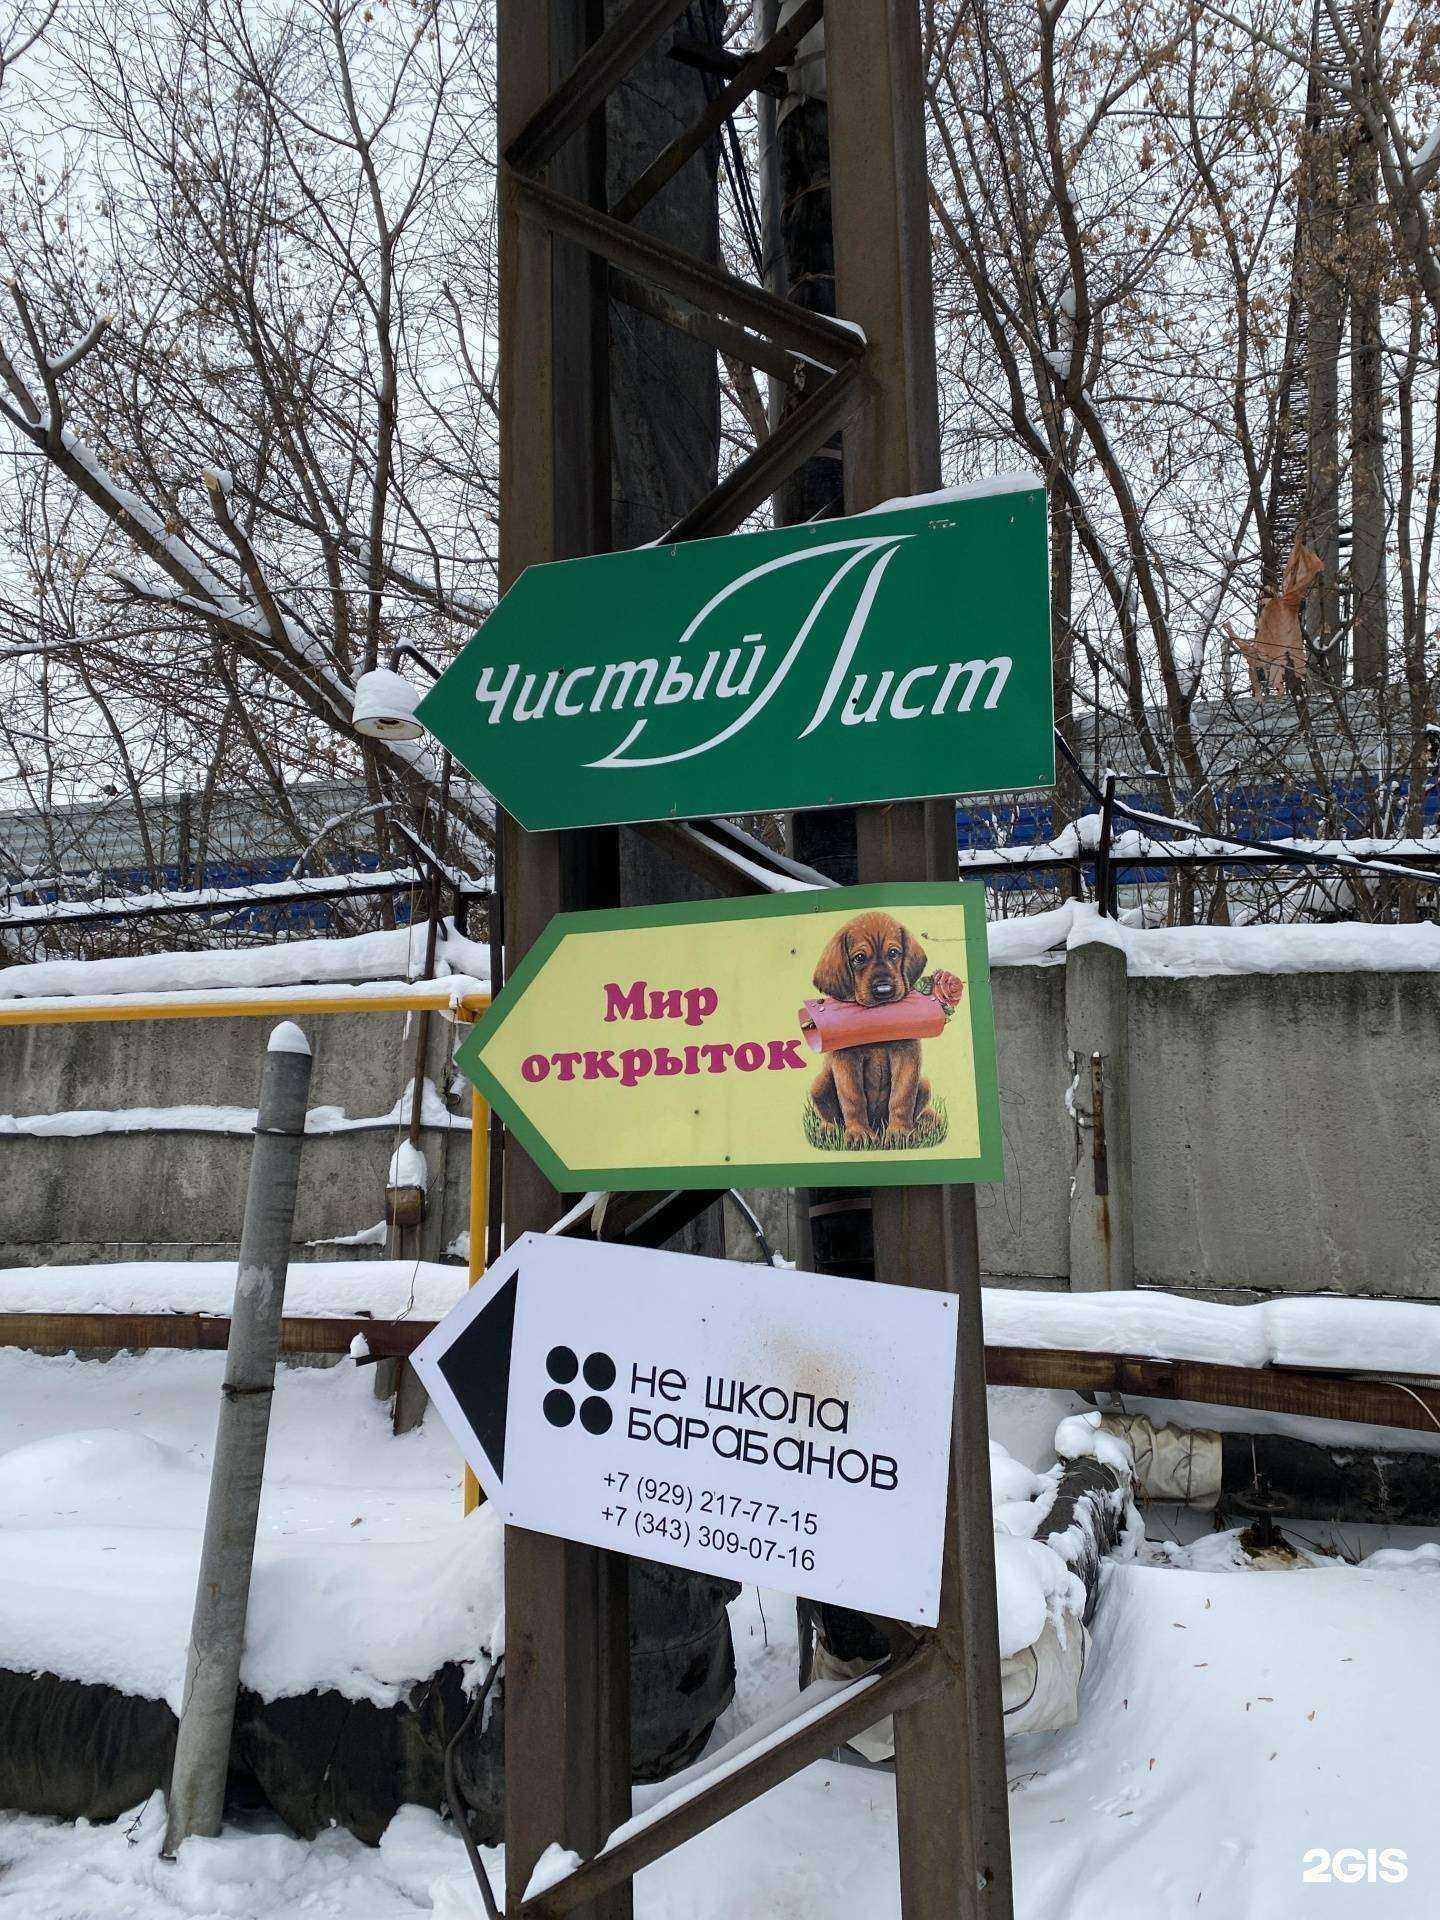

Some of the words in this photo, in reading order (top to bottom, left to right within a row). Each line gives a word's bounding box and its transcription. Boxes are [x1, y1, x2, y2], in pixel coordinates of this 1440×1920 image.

[475, 633, 767, 725] Чистый
[603, 980, 719, 1027] Мир
[521, 1039, 807, 1087] открыток
[603, 1471, 630, 1493] +7
[637, 1476, 693, 1514] (929)
[699, 1490, 818, 1536] 217-77-15
[601, 1505, 628, 1527] +7
[634, 1510, 691, 1548] (343)
[698, 1525, 815, 1572] 309-07-16
